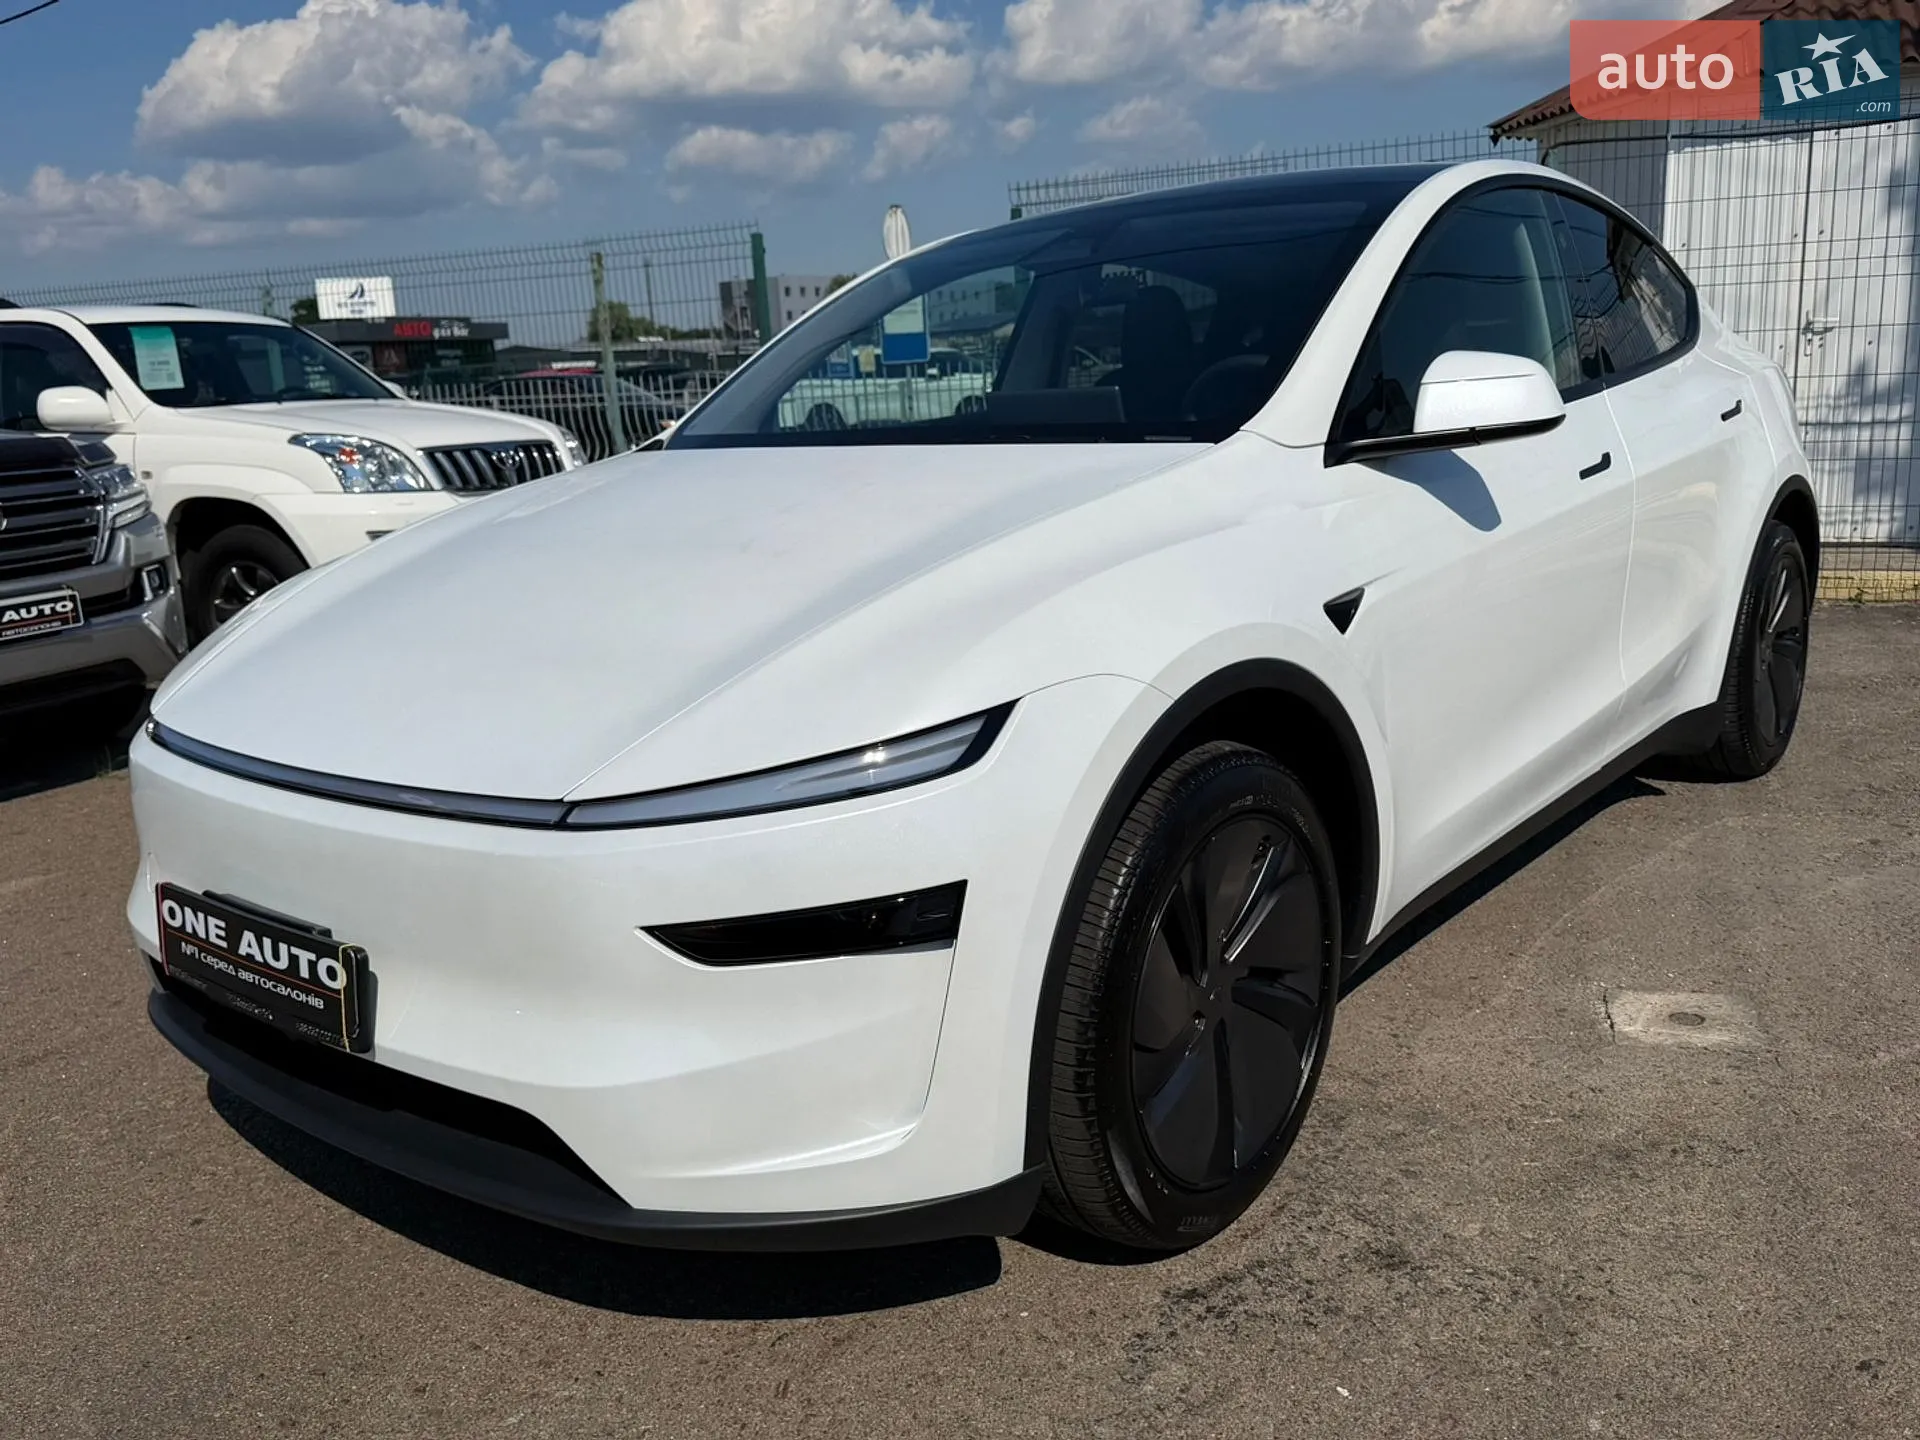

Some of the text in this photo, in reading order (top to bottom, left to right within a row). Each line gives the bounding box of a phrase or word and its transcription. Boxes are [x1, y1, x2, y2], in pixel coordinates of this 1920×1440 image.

[0, 600, 75, 624] AUTO
[162, 898, 229, 949] ONE
[237, 929, 348, 990] AUTO
[200, 951, 236, 977] серед
[237, 966, 325, 1010] автосалонів
